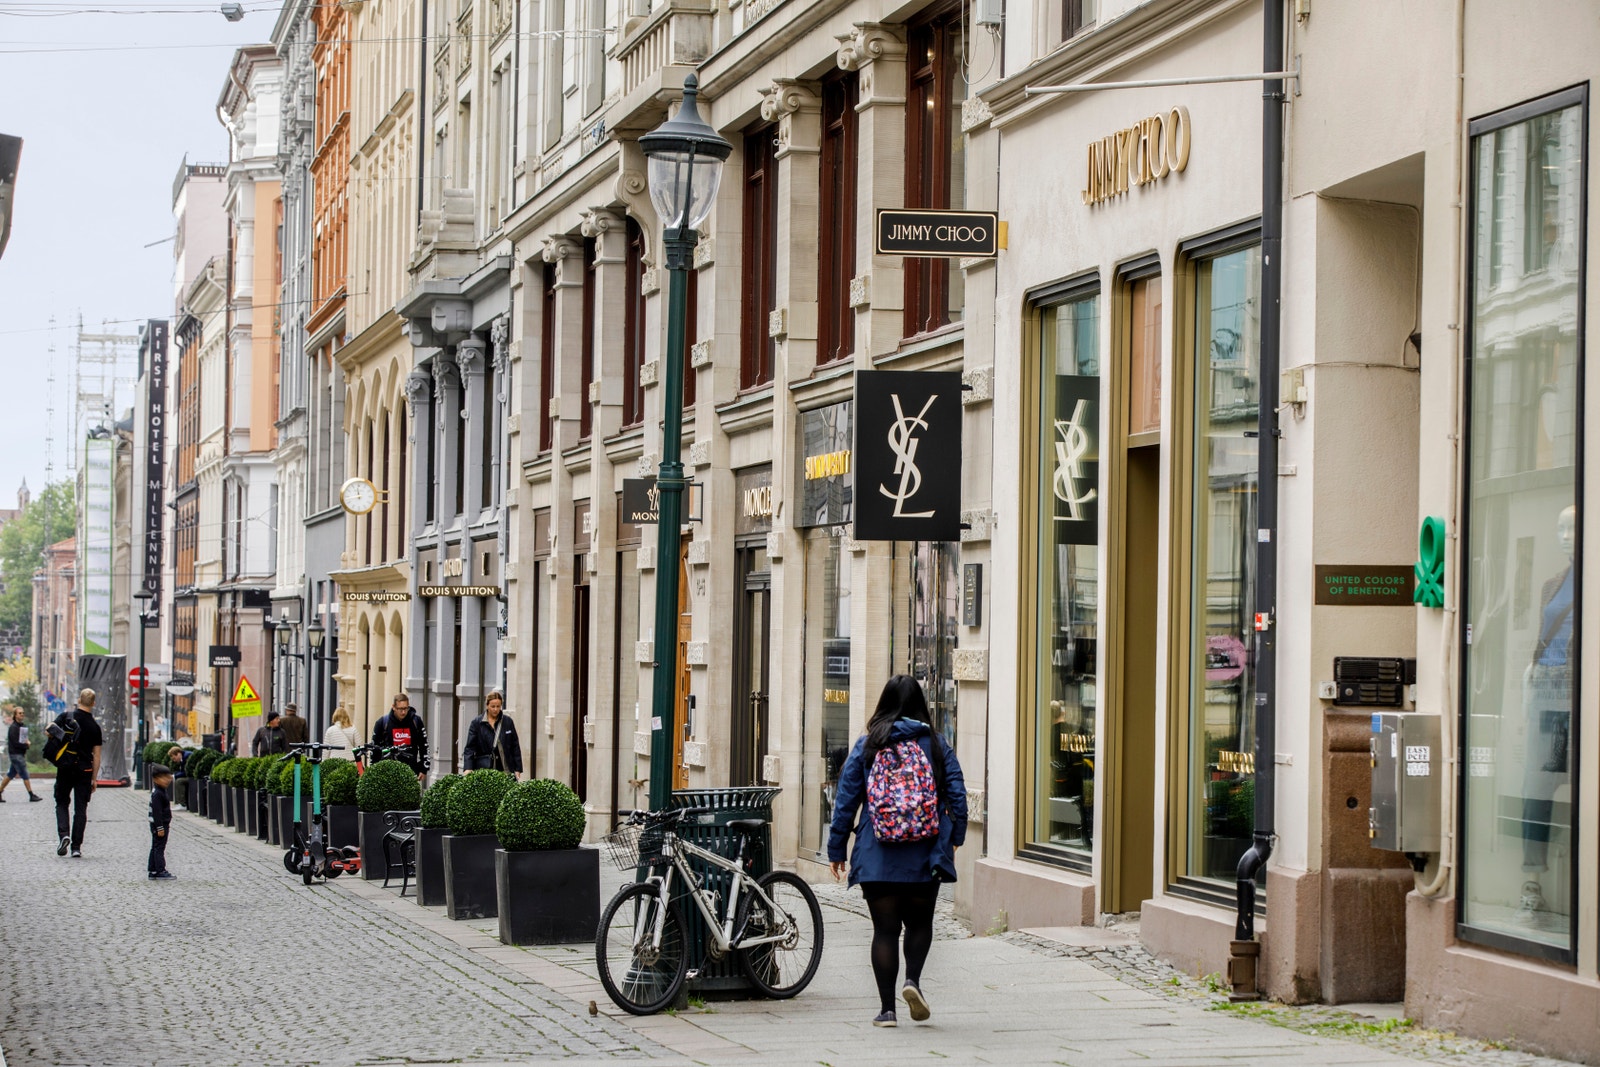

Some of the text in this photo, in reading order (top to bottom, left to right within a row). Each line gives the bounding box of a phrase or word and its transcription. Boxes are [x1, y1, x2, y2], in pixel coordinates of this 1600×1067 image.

[1081, 105, 1191, 206] JIMMY CHOO
[887, 224, 987, 242] JIMMY CHOO
[153, 327, 162, 388] FIRST
[151, 403, 161, 465] HOTEL
[743, 486, 772, 518] MONCLE
[631, 512, 660, 521] MON
[1324, 576, 1405, 585] UNITED COLORS
[345, 592, 407, 601] LOUIS VUITTON
[421, 586, 495, 596] LOUIS VUITTON
[1329, 586, 1344, 595] OF
